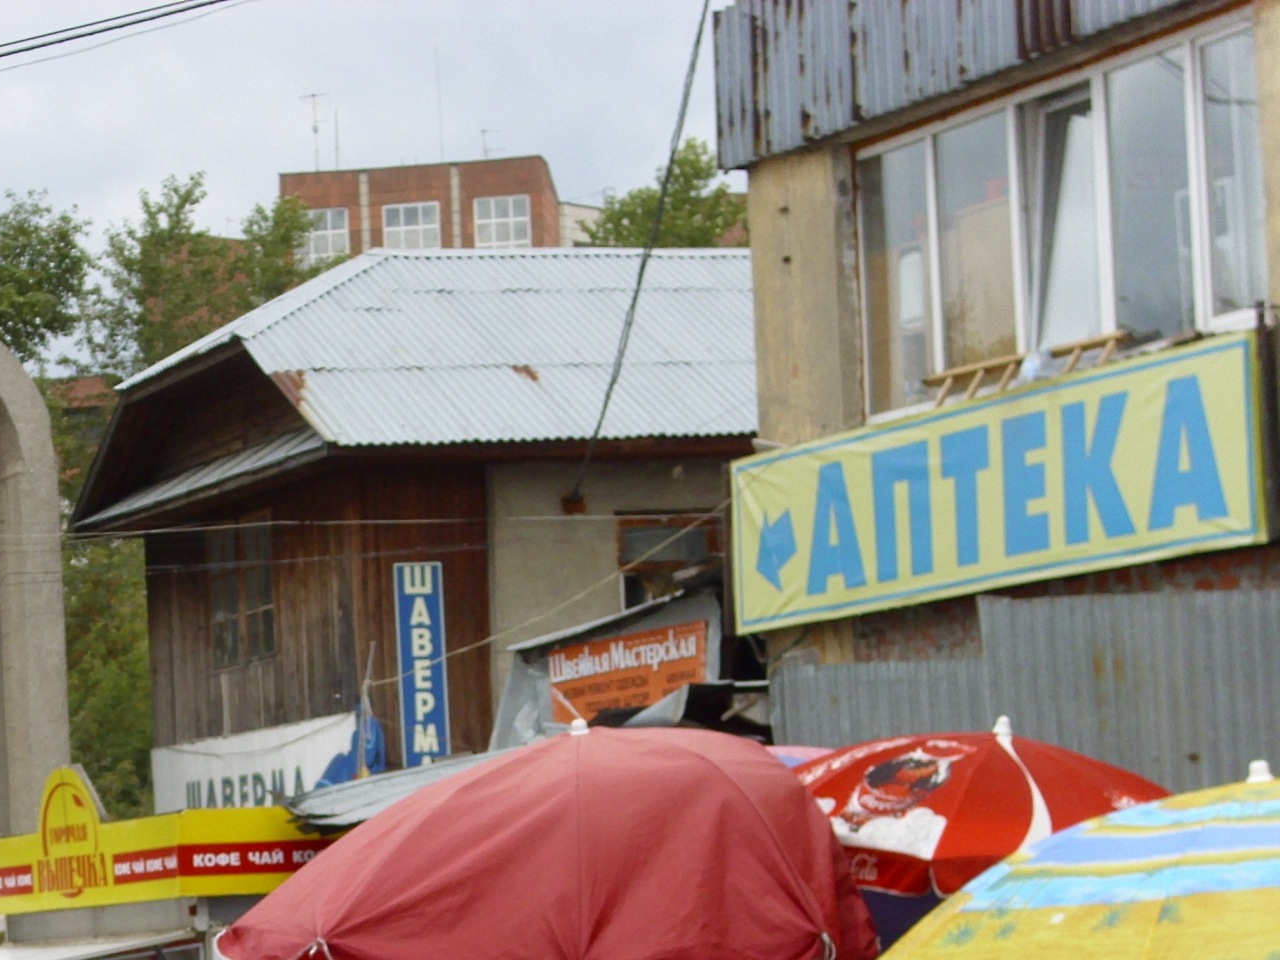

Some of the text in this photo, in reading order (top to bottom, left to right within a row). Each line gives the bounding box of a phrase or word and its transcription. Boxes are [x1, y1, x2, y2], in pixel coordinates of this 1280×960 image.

[805, 373, 1230, 596] АПТЕКА
[38, 852, 108, 893] ВЫПЕЧКА
[193, 848, 319, 867] КОФЕ ЧАЙ КО
